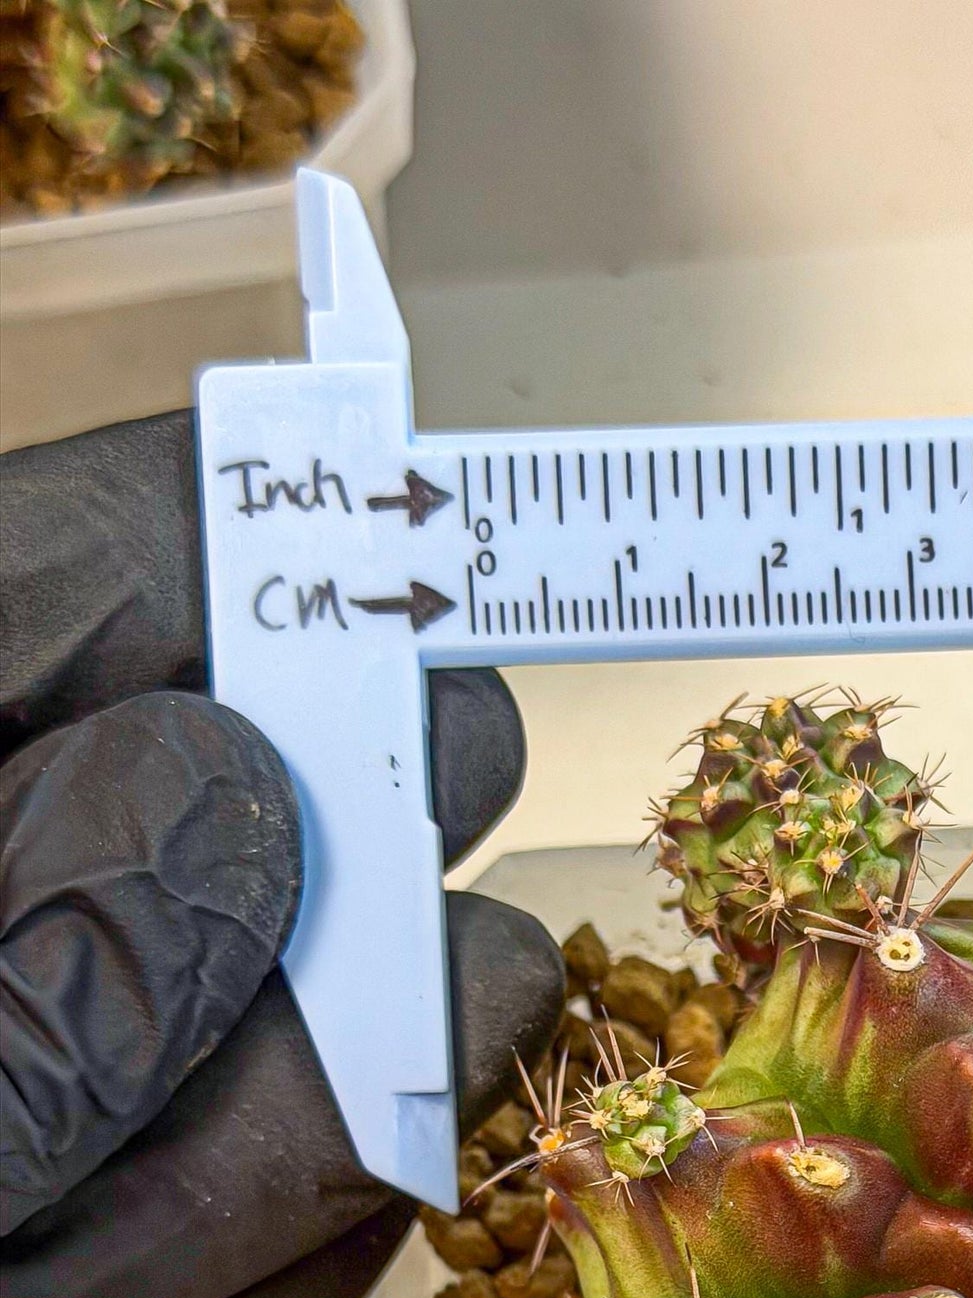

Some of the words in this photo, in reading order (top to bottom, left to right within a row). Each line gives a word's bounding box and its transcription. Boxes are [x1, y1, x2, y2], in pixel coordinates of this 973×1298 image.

[217, 457, 353, 519] Inch
[474, 516, 494, 544] 0
[849, 507, 864, 533] 1
[475, 549, 497, 577] 0
[624, 544, 639, 573] 1
[770, 541, 789, 568] 2
[918, 536, 937, 563] 3
